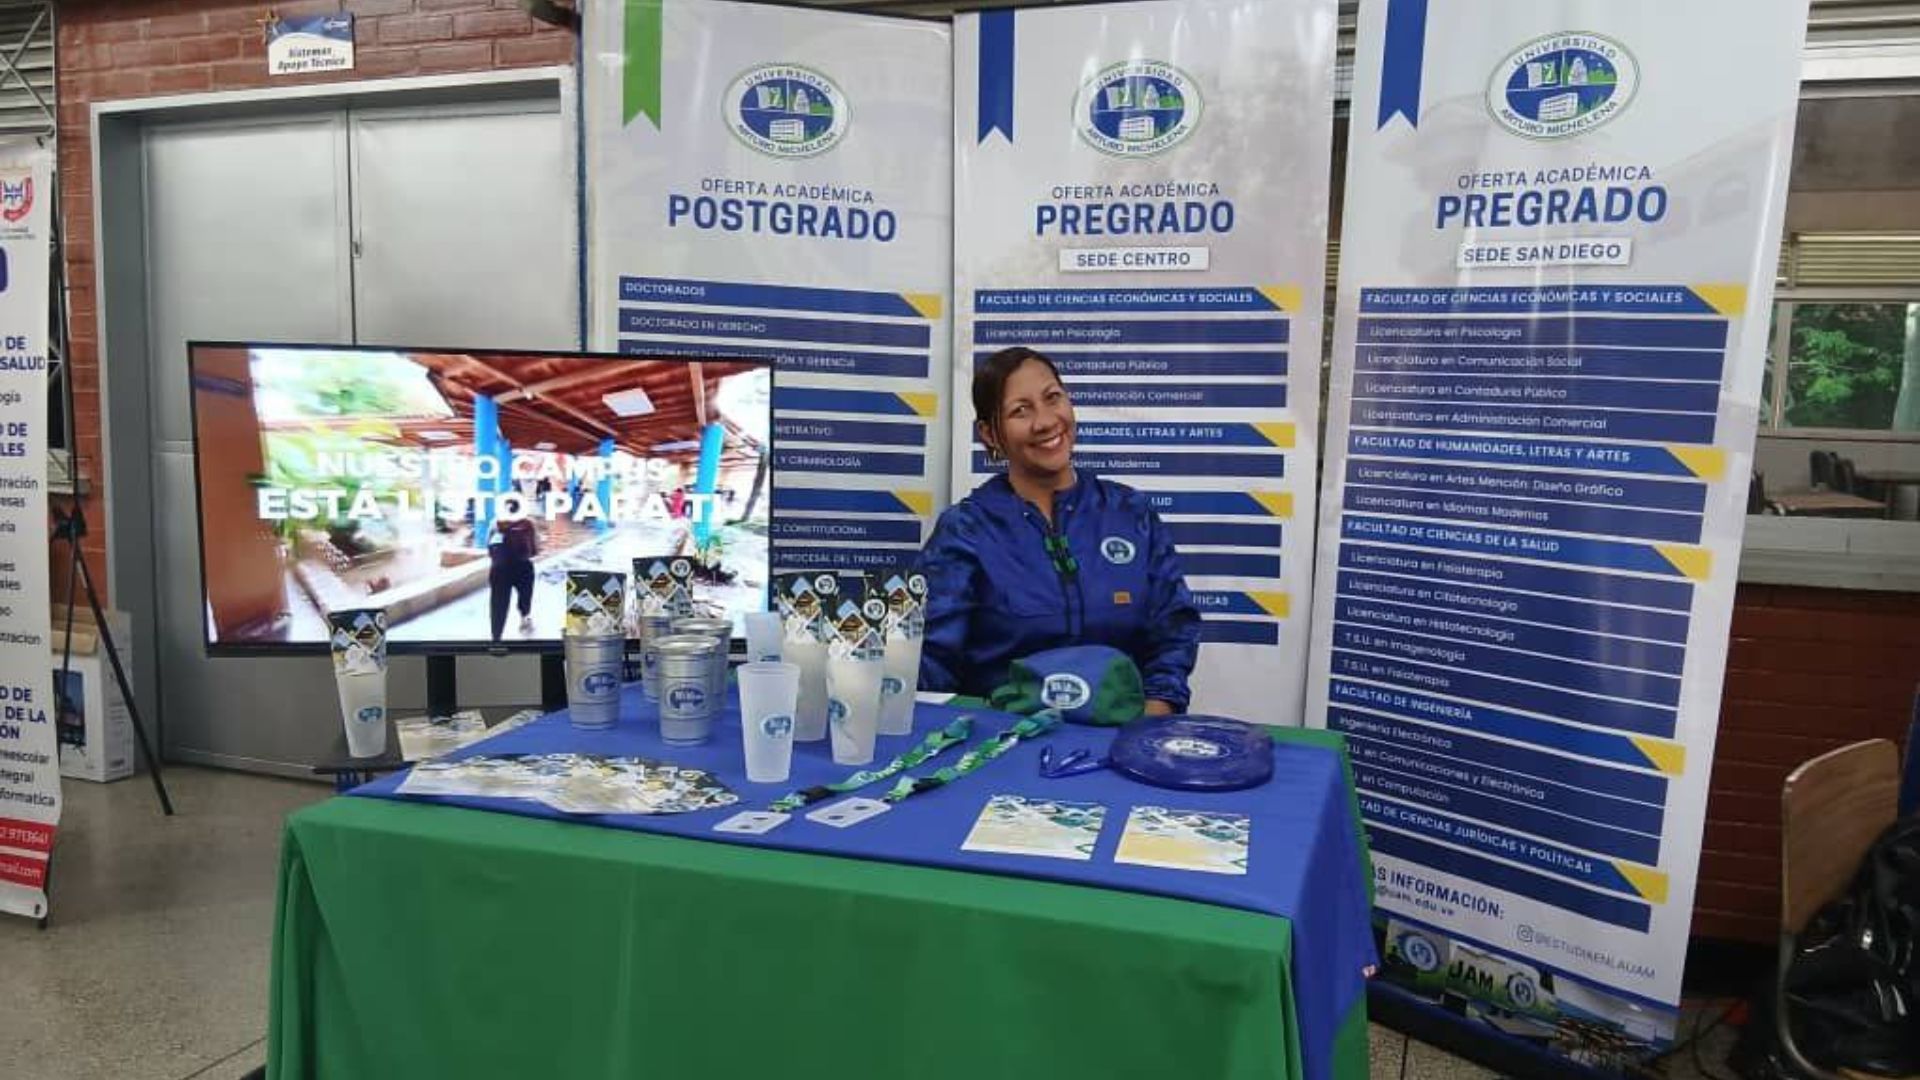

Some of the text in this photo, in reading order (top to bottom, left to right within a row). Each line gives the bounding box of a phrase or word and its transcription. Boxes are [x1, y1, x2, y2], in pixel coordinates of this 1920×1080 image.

[1513, 37, 1618, 67] UNIVERSIDAD
[1500, 100, 1619, 134] ARTURO MICHELENA
[1087, 125, 1125, 153] ARTURO
[1457, 161, 1652, 190] OFERTA ACADÉMICA
[701, 178, 874, 205] OFERTA ACADÉMICA
[1052, 180, 1220, 200] OFERTA ACADÉMICA
[1435, 184, 1669, 230] PREGRADO
[668, 194, 896, 243] POSTGRADO
[1036, 199, 1234, 236] PREGRADO
[1076, 251, 1191, 267] SEDE CENTRO
[1464, 243, 1622, 263] SEDE SAN DIEGO
[625, 282, 706, 297] DOCTORADOS
[980, 290, 1253, 305] FACULTAD DE CIENCIAS ECONÓMICAS Y SOCIALES
[1367, 289, 1684, 305] FACULTAD DE CIENCIAS ECONÓMICAS Y SOCIALES
[630, 316, 766, 334] DOCTORADO EN DERECHO
[985, 327, 1050, 339] Licenciatura
[1051, 329, 1065, 338] en
[1370, 326, 1441, 338] Licenciatura
[1444, 328, 1458, 338] en
[5, 336, 26, 350] DE
[1367, 354, 1582, 368] Licenciatura en Comunicación Social
[1147, 389, 1204, 401] Comercial
[1365, 383, 1436, 396] Licenciatura
[1438, 386, 1452, 396] en
[1524, 385, 1567, 399] Pública
[7, 422, 28, 437] DE
[1362, 410, 1607, 429] Licenciatura en Administración Comercial
[1136, 427, 1176, 438] LETRAS
[1179, 427, 1187, 437] Y
[1189, 427, 1223, 439] ARTES
[1355, 435, 1631, 463] FACULTAD DE HUMANIDADES, LETRAS Y ARTES
[317, 451, 670, 481] NUESTRO CAMPUS
[1108, 458, 1160, 470] Modernos
[1358, 467, 1427, 482] Licenciatura
[1429, 473, 1443, 483] en
[1446, 474, 1475, 486] Artes
[1533, 479, 1572, 493] Diseño
[1575, 482, 1623, 498] Gráfico
[258, 483, 384, 522] ESTÁ
[398, 489, 531, 523] LISTO
[545, 490, 671, 523] PARA
[1356, 495, 1549, 522] Licenciatura en Idiomas Modernos
[1347, 520, 1560, 553] FACULTAD DE CIENCIAS DE LA SALUD
[1351, 552, 1503, 580] Licenciatura en Fisioterapia
[1349, 579, 1416, 597] Licenciatura
[1418, 588, 1432, 598] en
[1347, 606, 1412, 625] Licenciatura
[1413, 615, 1427, 626] en
[1374, 638, 1388, 648] en
[1371, 664, 1384, 674] en
[1387, 665, 1450, 688] Fisioterapia
[12, 687, 32, 701] DE
[1335, 685, 1473, 721] FACULTAD DE INGENIERÍA
[4, 706, 47, 724] DE LA
[1392, 726, 1453, 749] Electrónica
[1364, 749, 1545, 800] en Comunicaciones y Electrónica
[1362, 774, 1450, 803] en Computación
[1383, 806, 1397, 818] DE
[1400, 812, 1452, 834] CIENCIAS
[1454, 826, 1517, 852] JURÍDICAS
[1520, 843, 1528, 854] Y
[1530, 845, 1594, 874] POLÍTICAS
